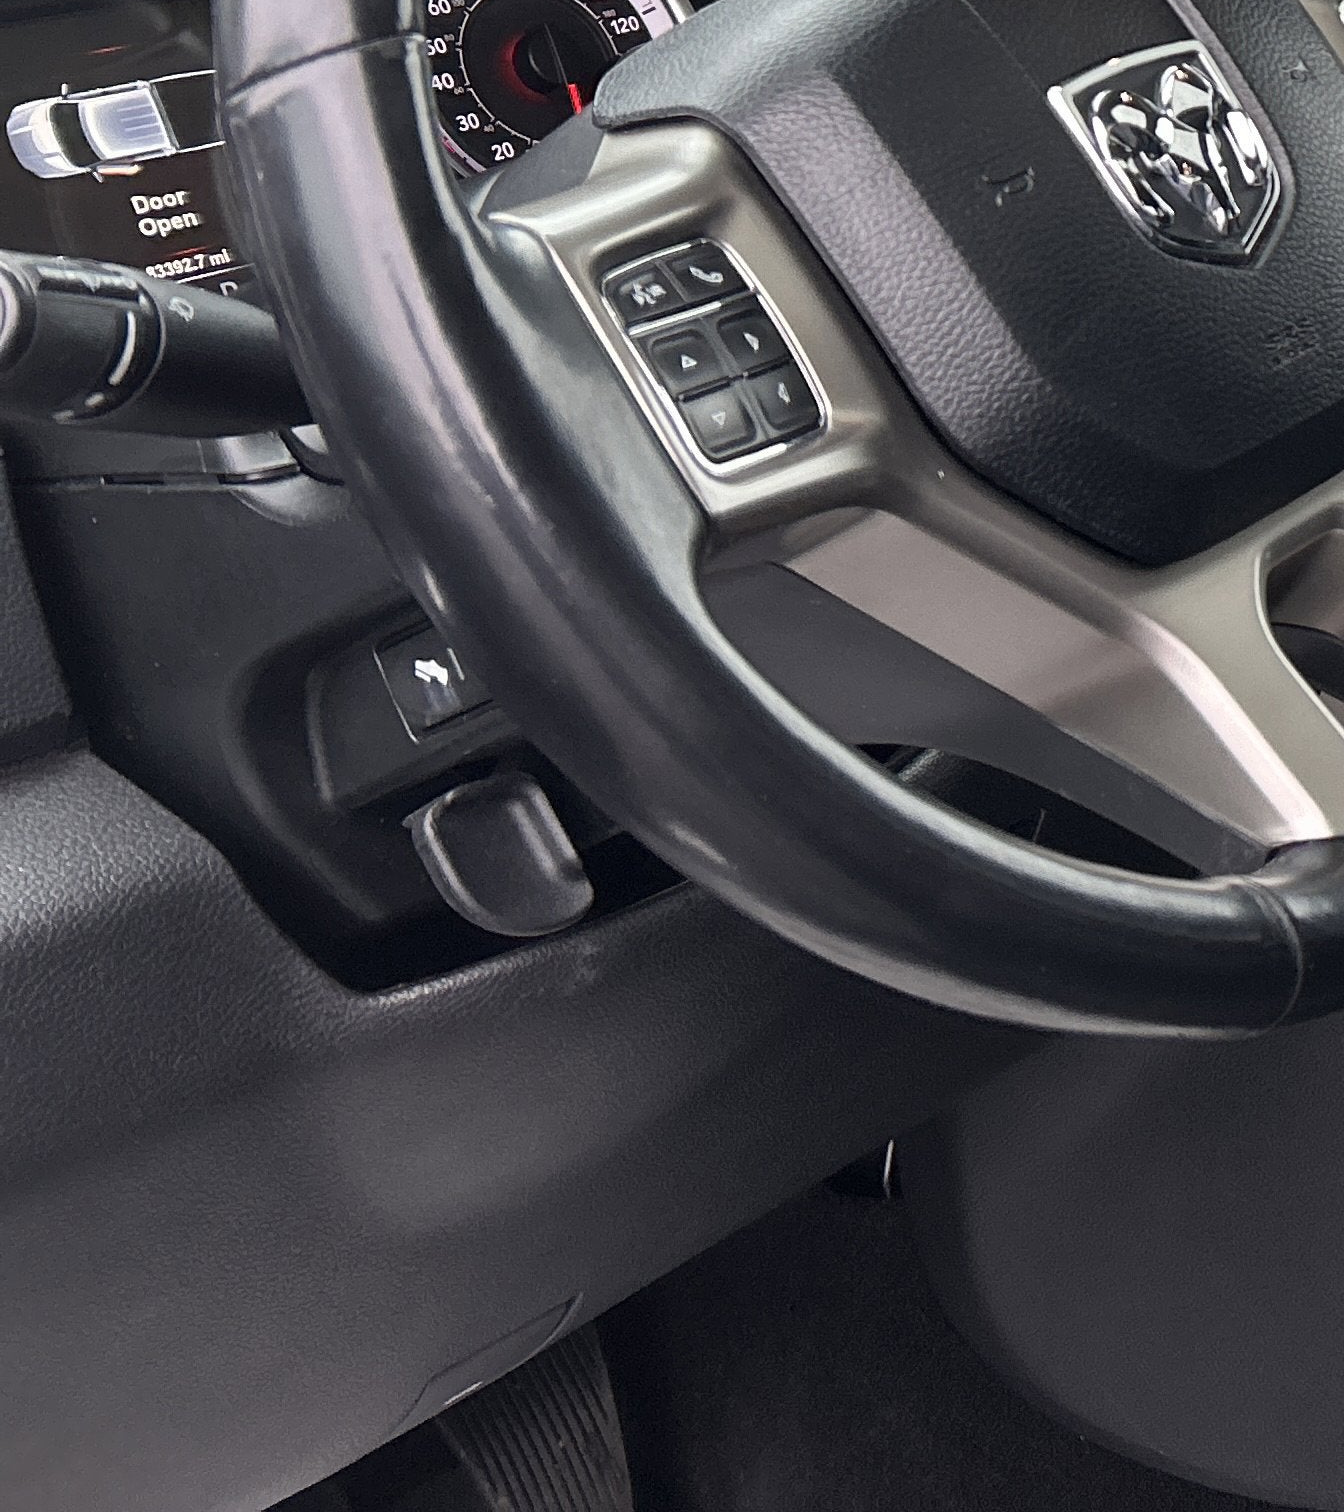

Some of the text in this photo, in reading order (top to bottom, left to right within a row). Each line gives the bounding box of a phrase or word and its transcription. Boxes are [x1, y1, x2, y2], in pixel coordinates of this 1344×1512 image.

[610, 15, 640, 35] 120
[427, 38, 447, 56] 50
[431, 72, 455, 91] 40
[455, 112, 480, 131] 30
[491, 142, 515, 161] 20
[131, 191, 186, 215] Door
[138, 212, 199, 237] Open
[209, 248, 231, 267] mi
